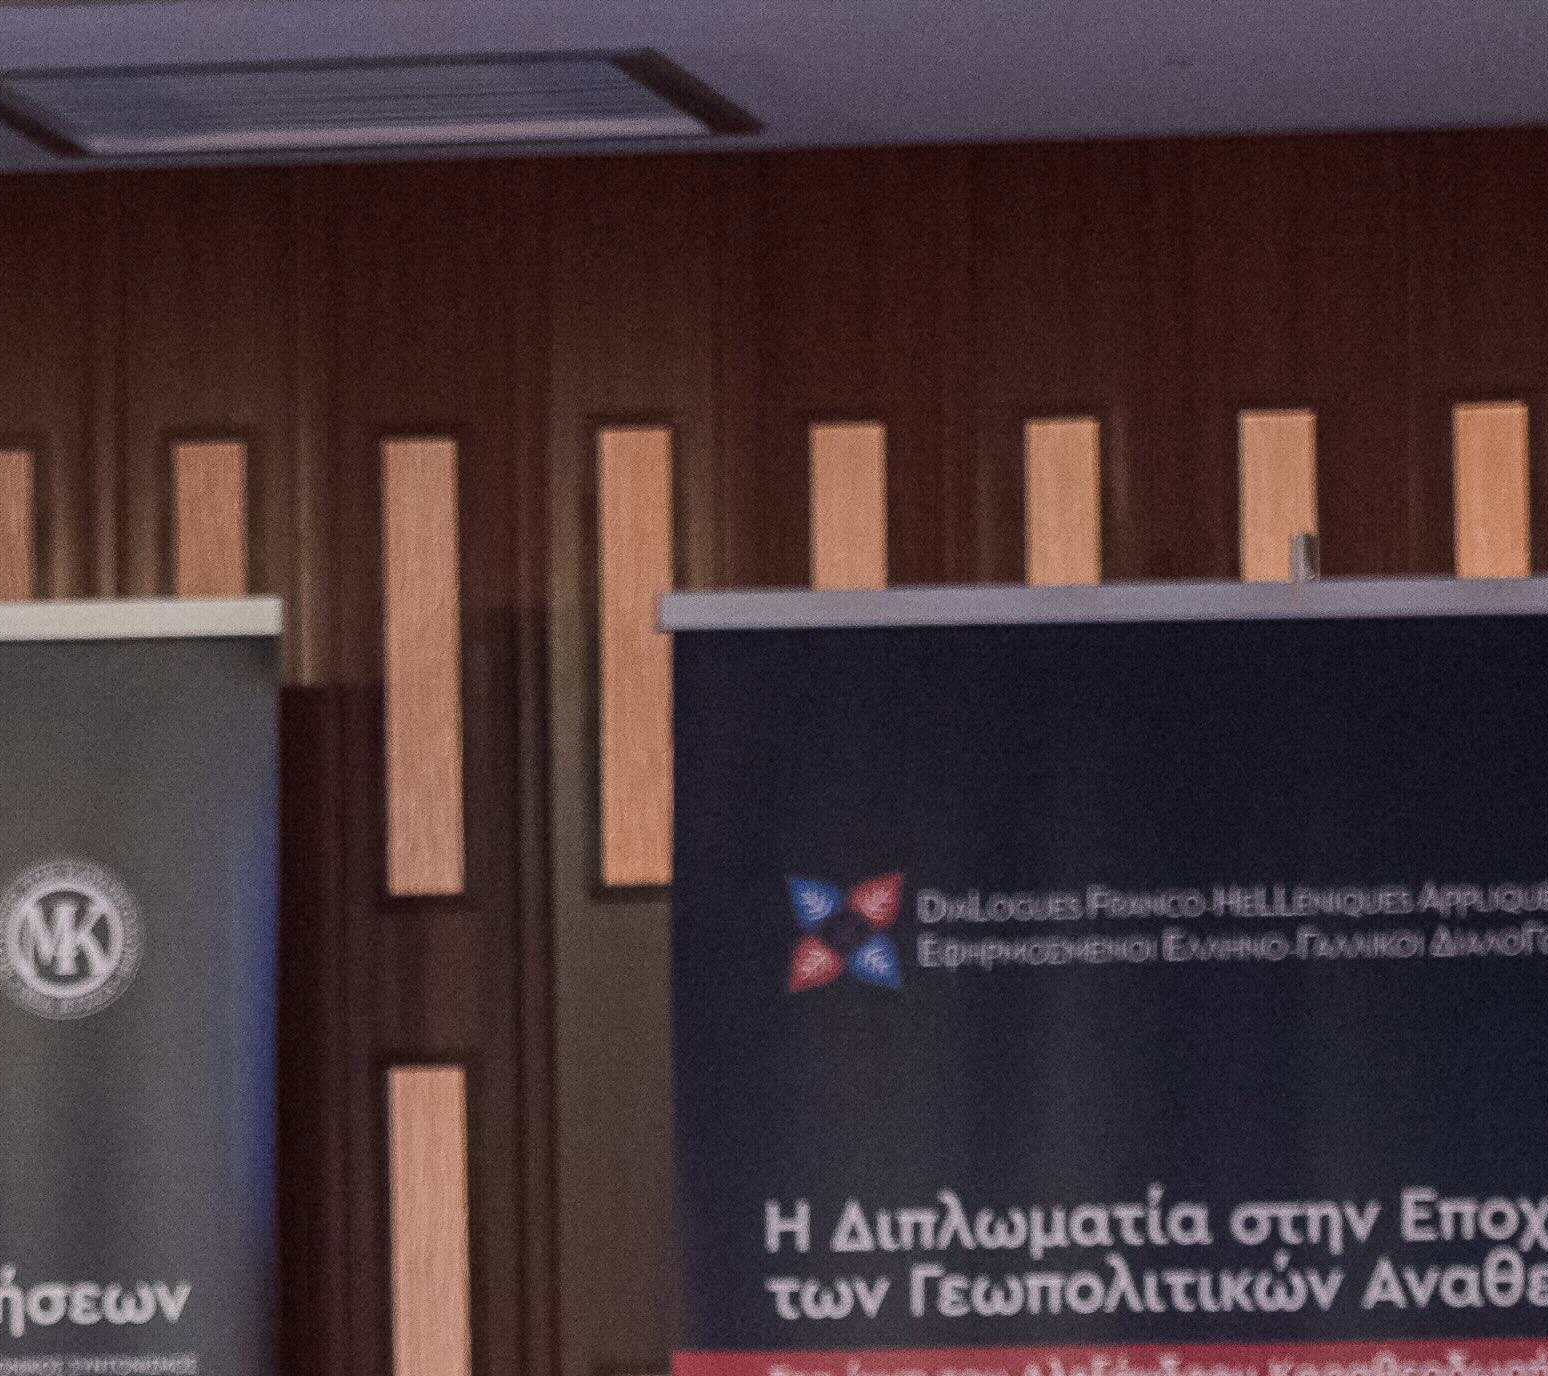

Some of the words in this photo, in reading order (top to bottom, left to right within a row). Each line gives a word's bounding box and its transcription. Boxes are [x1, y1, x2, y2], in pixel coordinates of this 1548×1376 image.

[764, 1198, 810, 1253] Η
[829, 1182, 1213, 1261] Διπλωματία
[1230, 1200, 1381, 1256] στην
[765, 1274, 890, 1320] των
[909, 1250, 1345, 1318] Γεωπολιτικών
